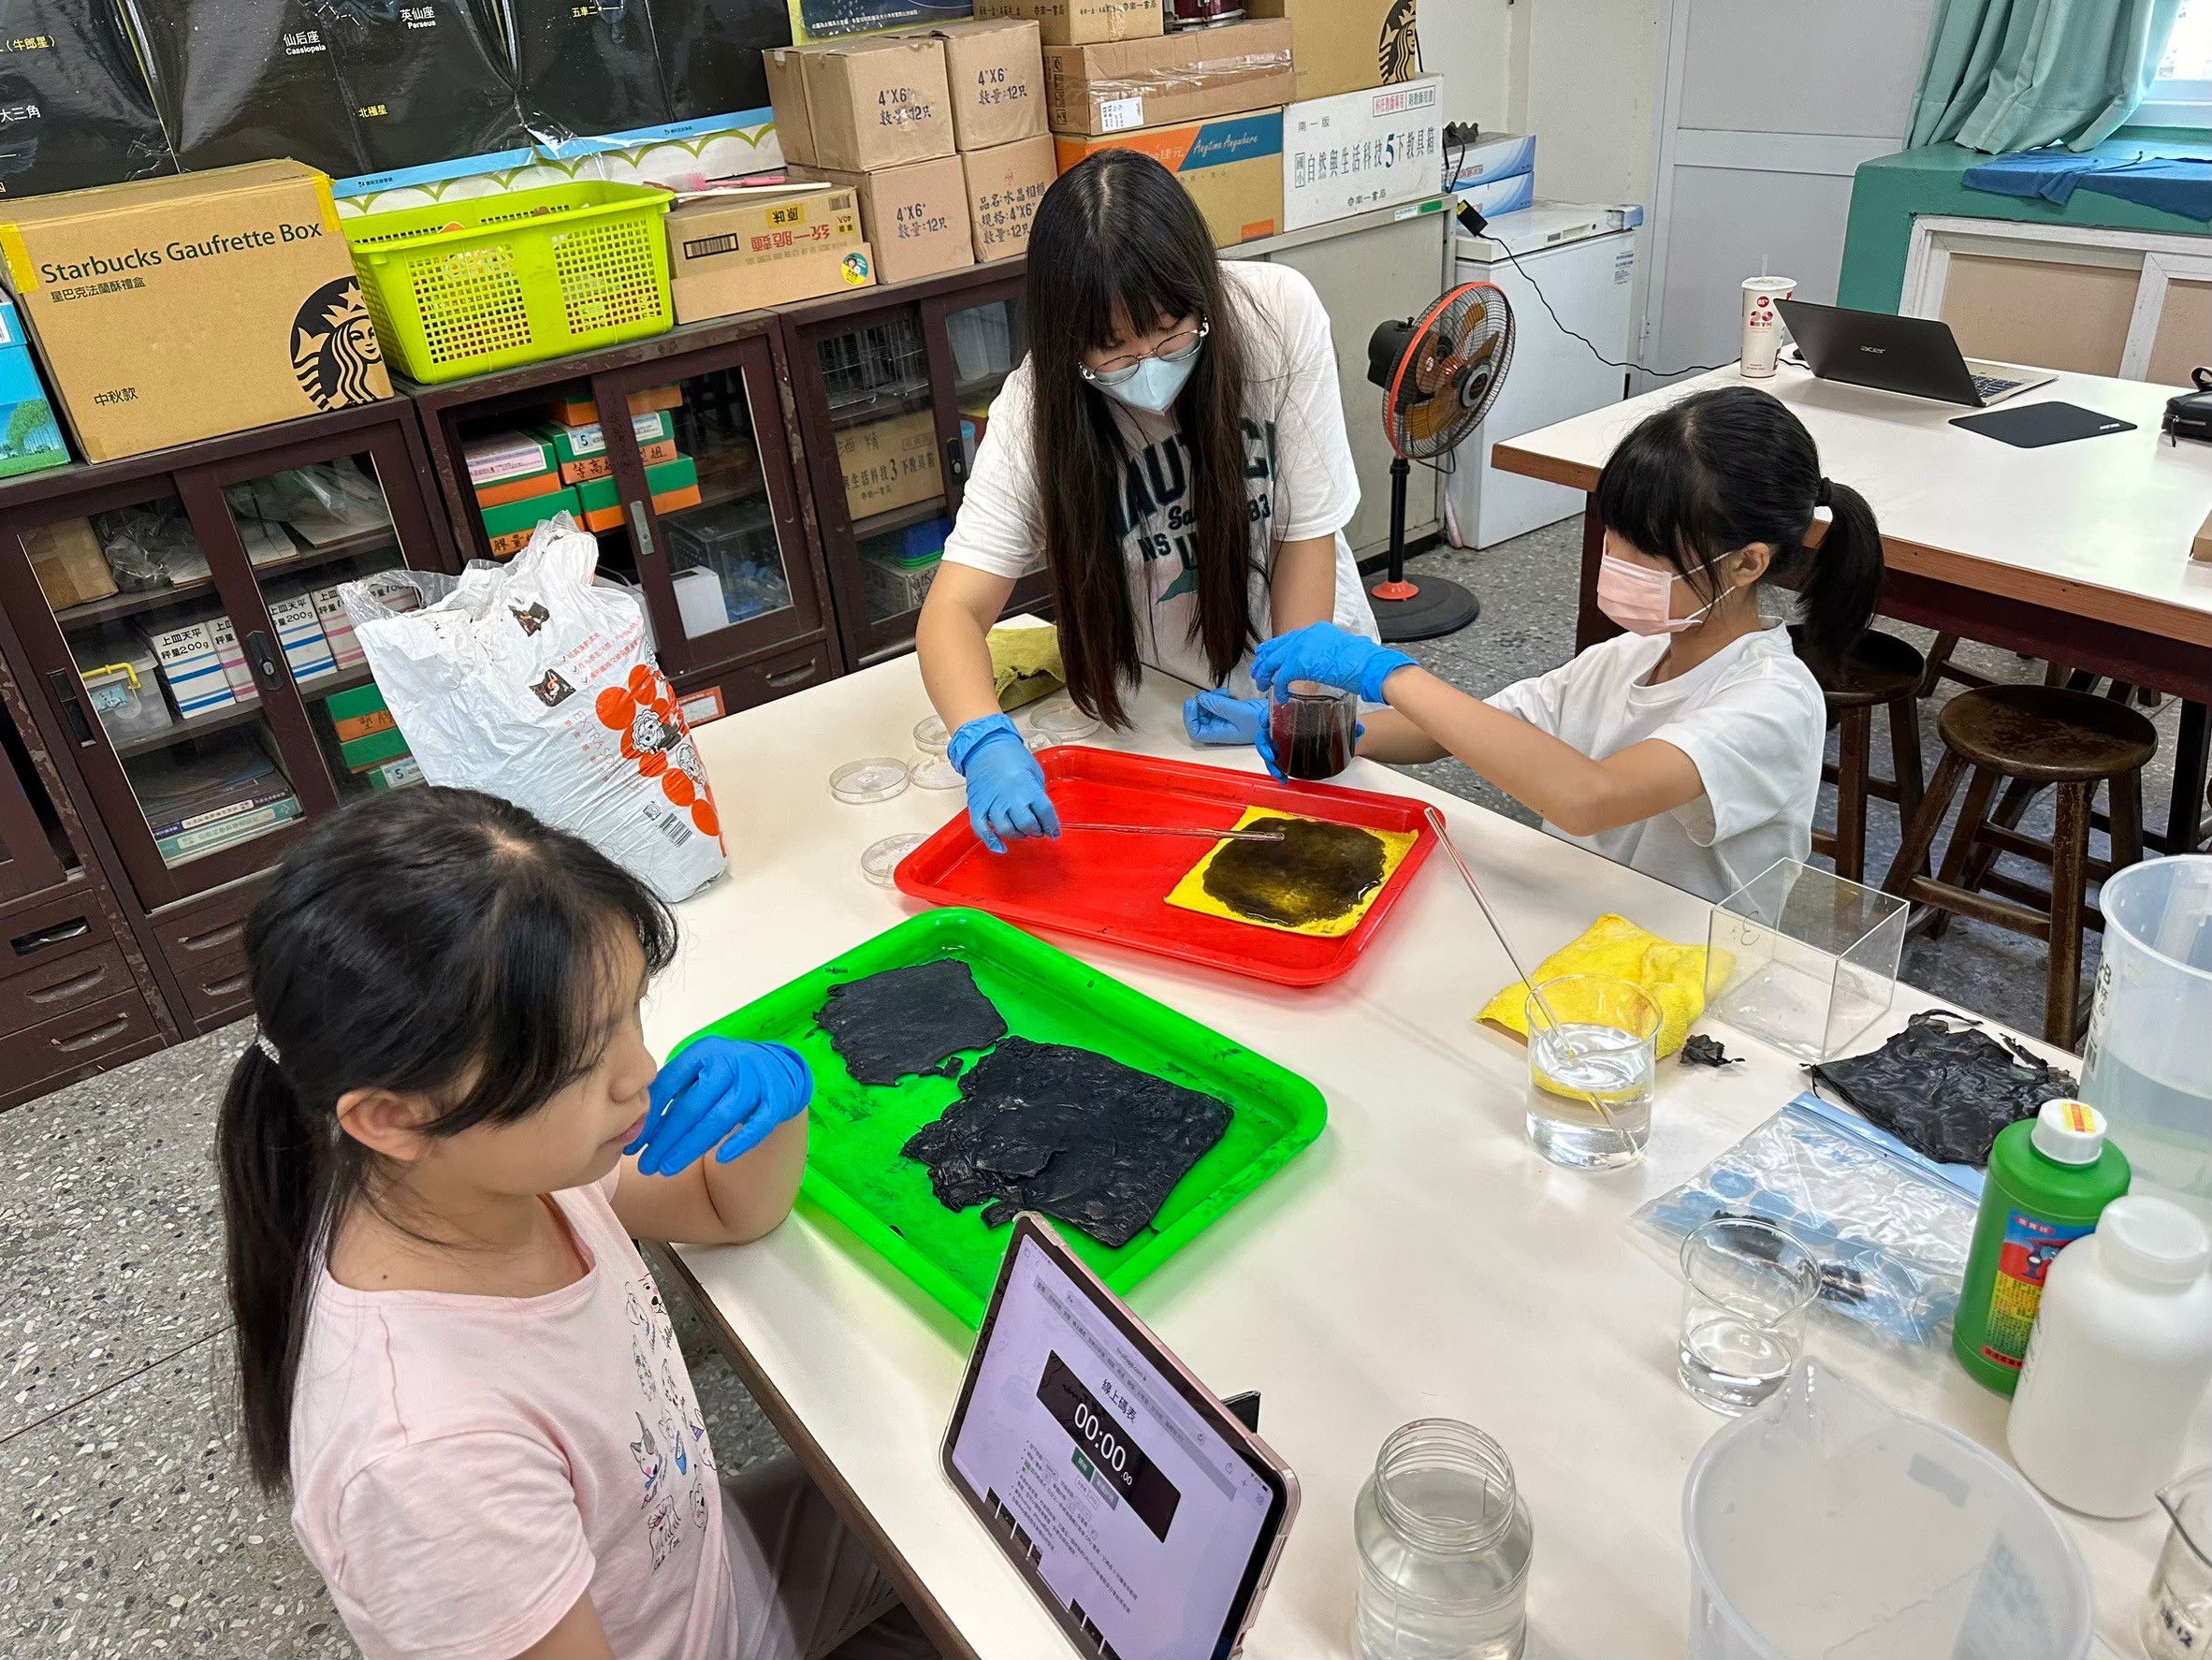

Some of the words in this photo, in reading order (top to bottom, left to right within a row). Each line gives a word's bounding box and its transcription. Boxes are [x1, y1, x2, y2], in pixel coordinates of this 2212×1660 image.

[400, 6, 435, 22] 英仙座
[283, 30, 320, 47] 仙后座
[772, 207, 798, 224] 原味
[41, 248, 163, 284] Starbucks
[166, 231, 275, 262] Gaufrette
[279, 220, 323, 242] Box
[51, 276, 146, 303] 星巴克法蘭酥禮盒
[1861, 345, 1885, 354] acer
[94, 386, 138, 407] 中秋款
[162, 628, 201, 647] 上皿天平
[161, 641, 210, 660] 秤量200g
[1101, 1378, 1137, 1423] 線上碼表
